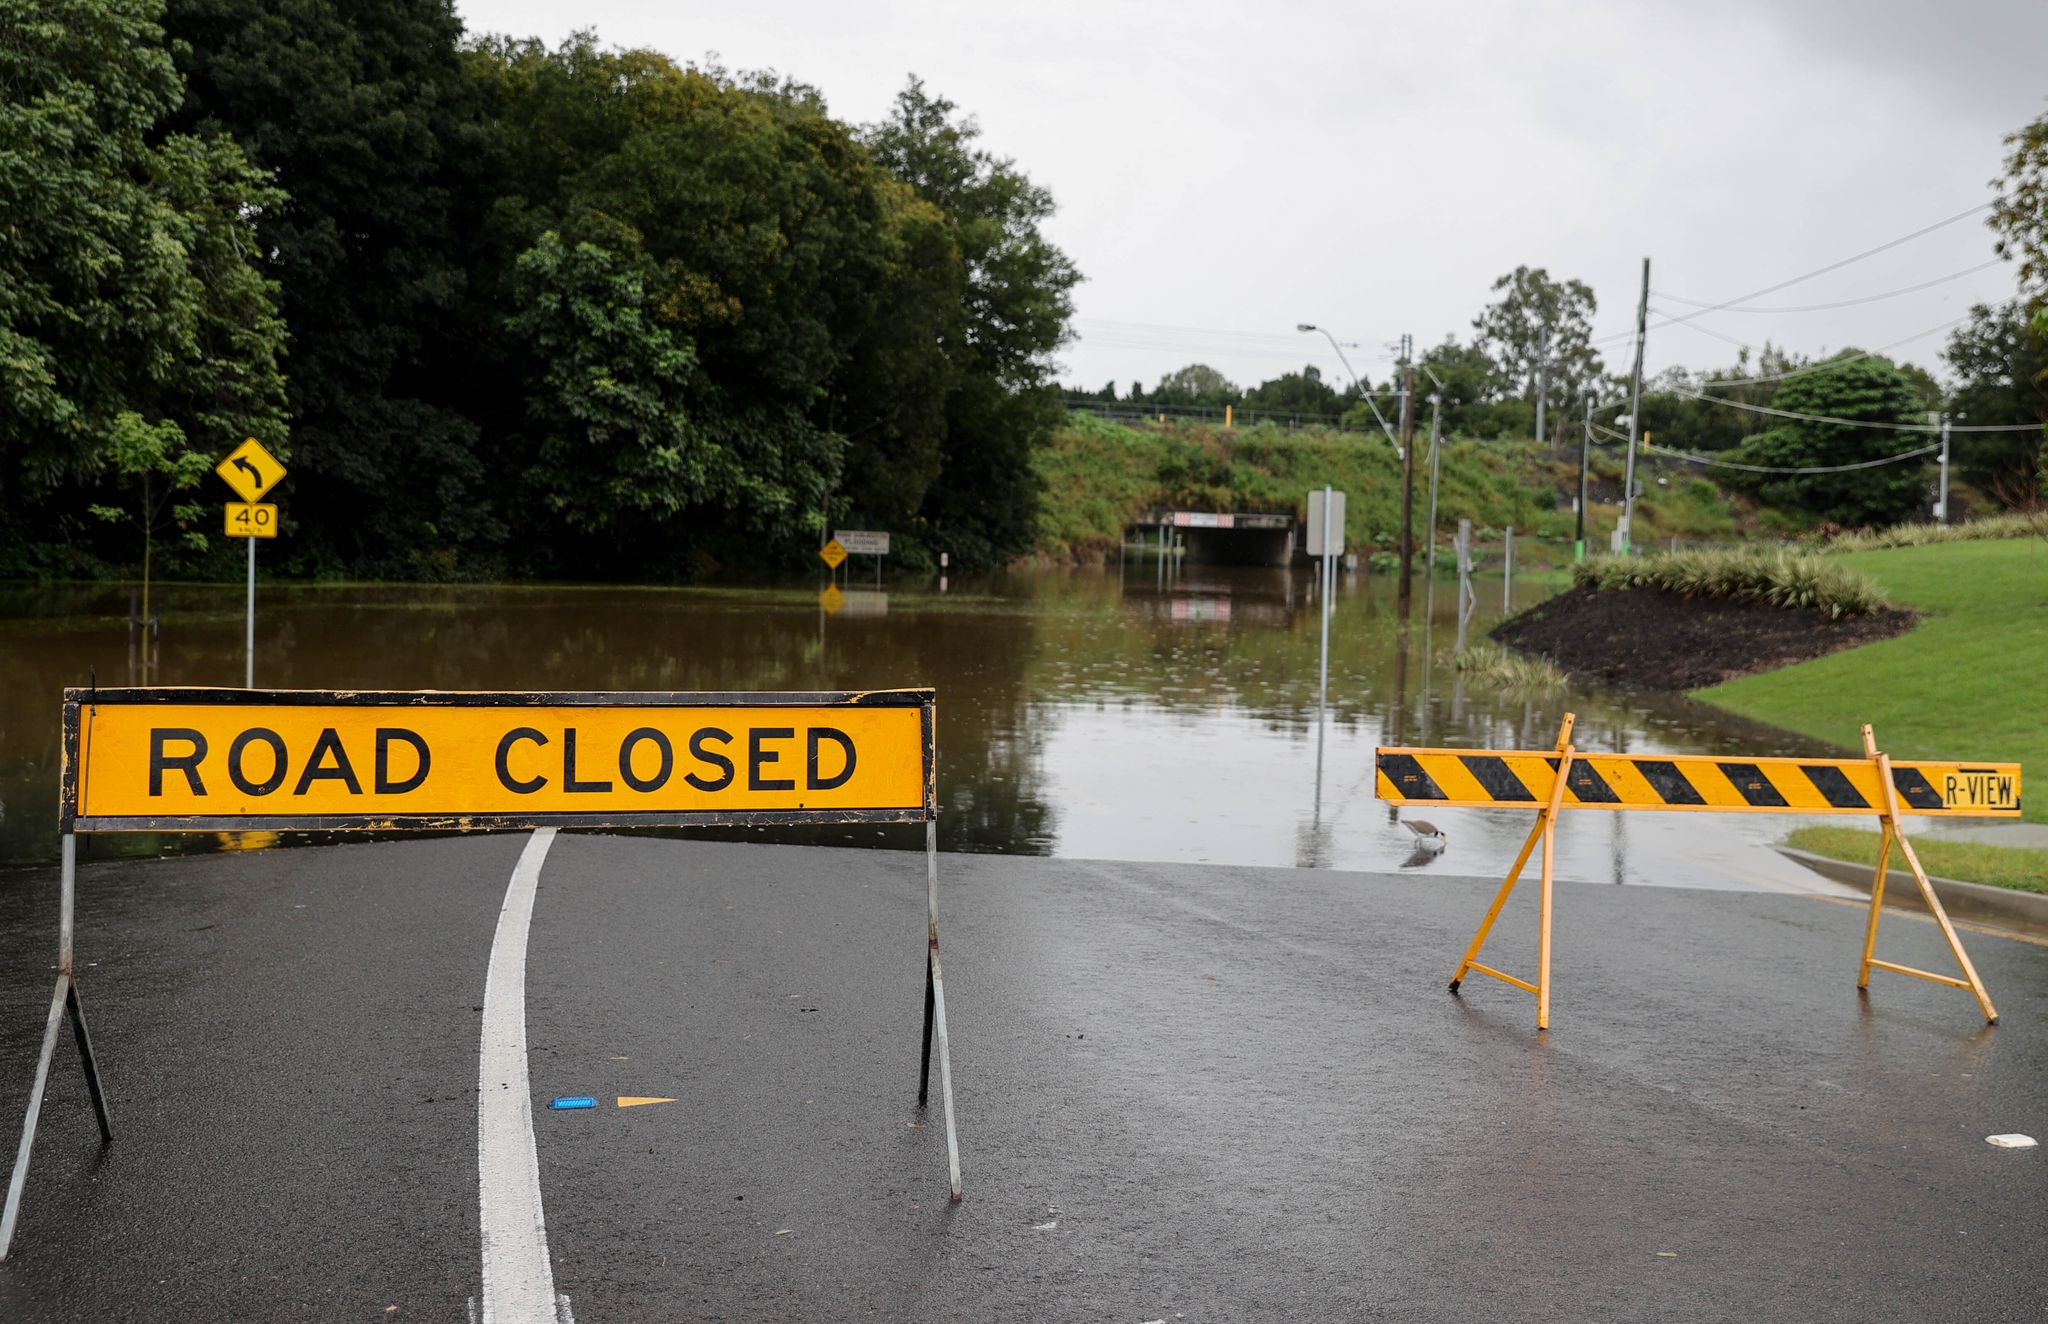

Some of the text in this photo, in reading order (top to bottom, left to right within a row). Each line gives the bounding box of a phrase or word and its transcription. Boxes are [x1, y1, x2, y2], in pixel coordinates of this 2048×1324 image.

[235, 509, 269, 525] 40
[148, 727, 857, 797] ROAD CLOSED
[1946, 775, 2012, 805] R-VIEW
